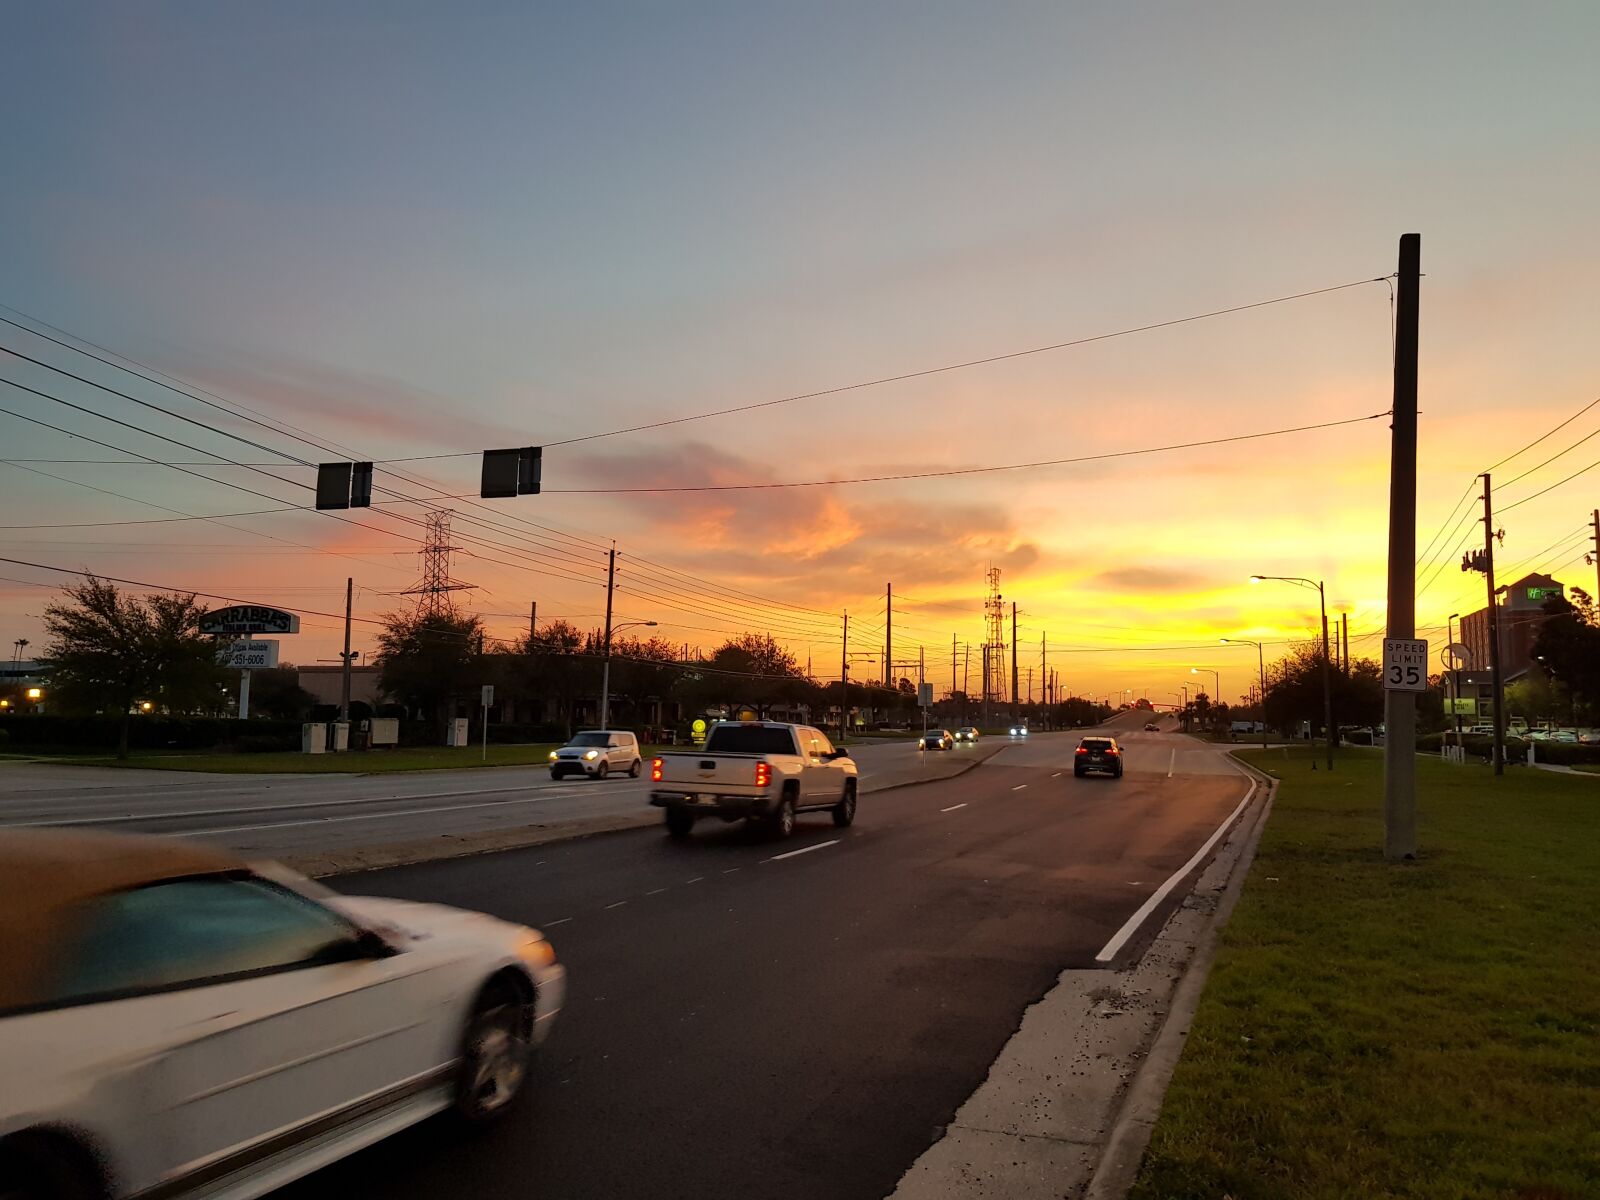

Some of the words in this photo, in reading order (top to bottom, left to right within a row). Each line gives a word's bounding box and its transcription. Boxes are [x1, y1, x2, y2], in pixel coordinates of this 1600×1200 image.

[1387, 643, 1425, 652] SPEED
[1392, 654, 1423, 664] LIMIT
[1389, 666, 1419, 685] 35
